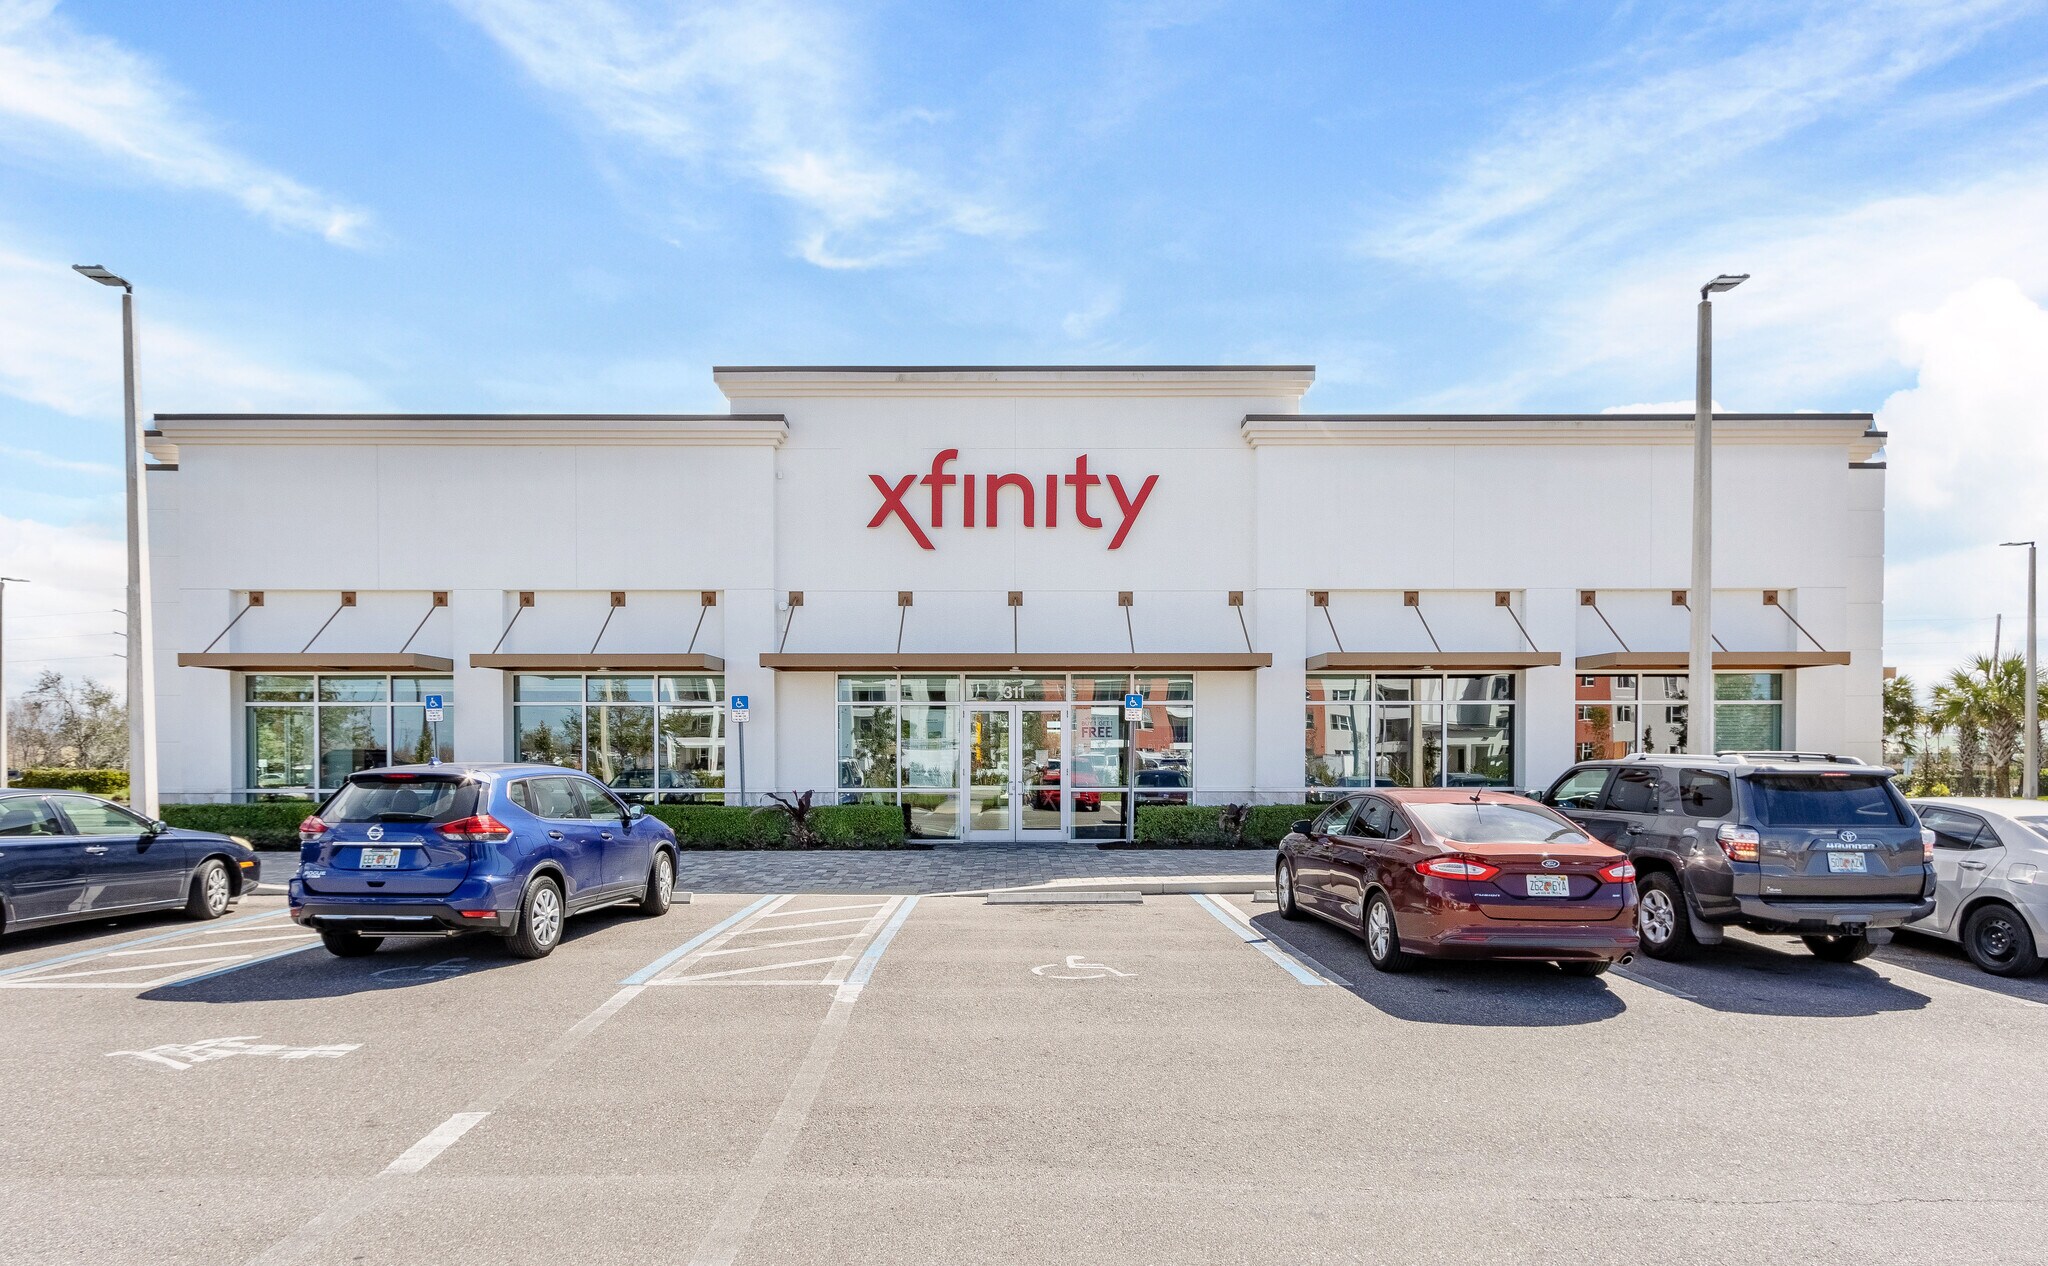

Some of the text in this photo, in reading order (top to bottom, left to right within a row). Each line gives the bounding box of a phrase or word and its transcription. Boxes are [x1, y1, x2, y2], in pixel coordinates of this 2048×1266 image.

[866, 448, 1160, 551] xfinity
[1003, 685, 1025, 699] 311
[1081, 726, 1113, 738] FREE
